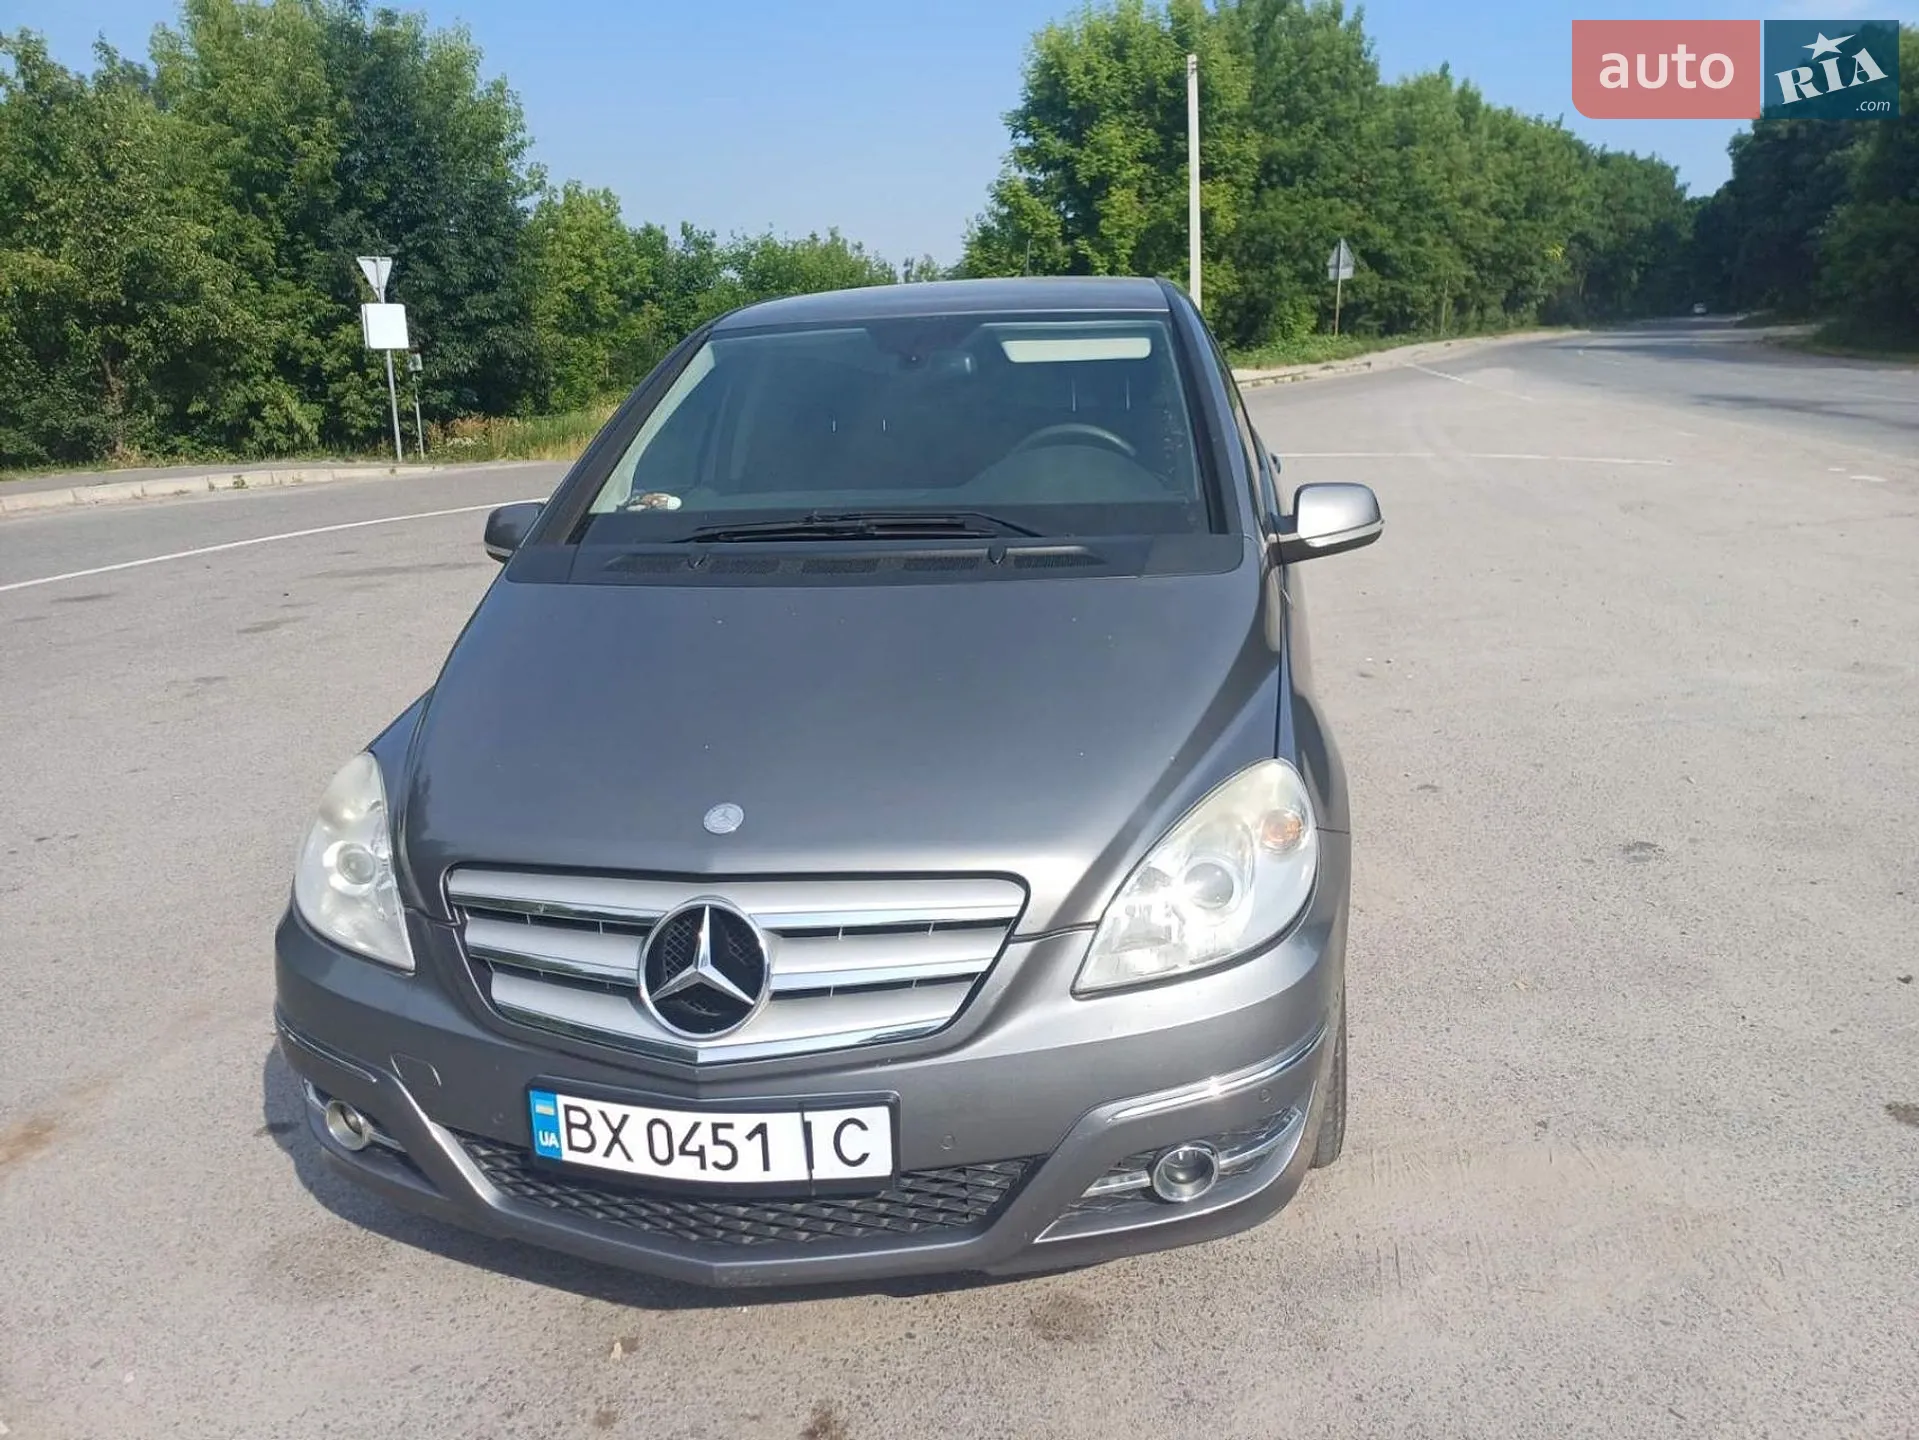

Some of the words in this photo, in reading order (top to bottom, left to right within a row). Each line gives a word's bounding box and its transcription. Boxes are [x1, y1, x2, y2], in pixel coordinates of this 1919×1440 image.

[538, 1130, 560, 1149] UA
[564, 1104, 634, 1162] BX
[646, 1117, 770, 1172] 0451
